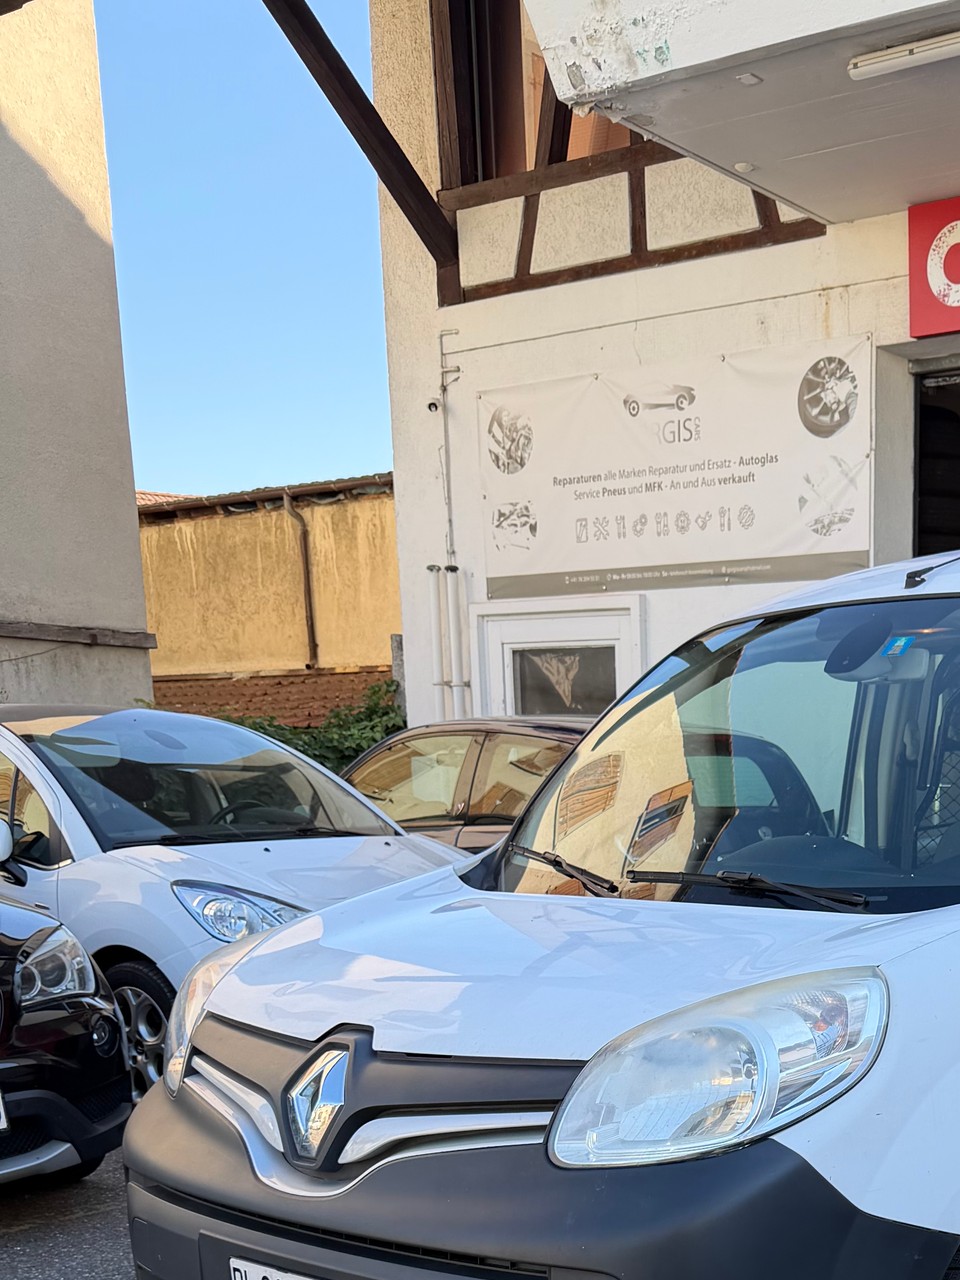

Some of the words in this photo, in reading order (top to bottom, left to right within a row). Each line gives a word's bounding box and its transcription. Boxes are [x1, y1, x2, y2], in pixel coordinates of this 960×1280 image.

[552, 473, 602, 488] Reparaturen
[603, 470, 617, 481] alle
[618, 467, 647, 480] Marken
[648, 464, 687, 478] Reparatur
[689, 459, 706, 472] und
[707, 459, 732, 471] Ersatz
[738, 453, 779, 467] Autoglas
[573, 488, 600, 501] Service
[601, 487, 627, 498] Pneus
[628, 483, 643, 495] und
[644, 481, 663, 493] MFK
[669, 480, 681, 490] An
[682, 477, 699, 489] und
[700, 477, 716, 488] Aus
[717, 471, 756, 486] verkauft
